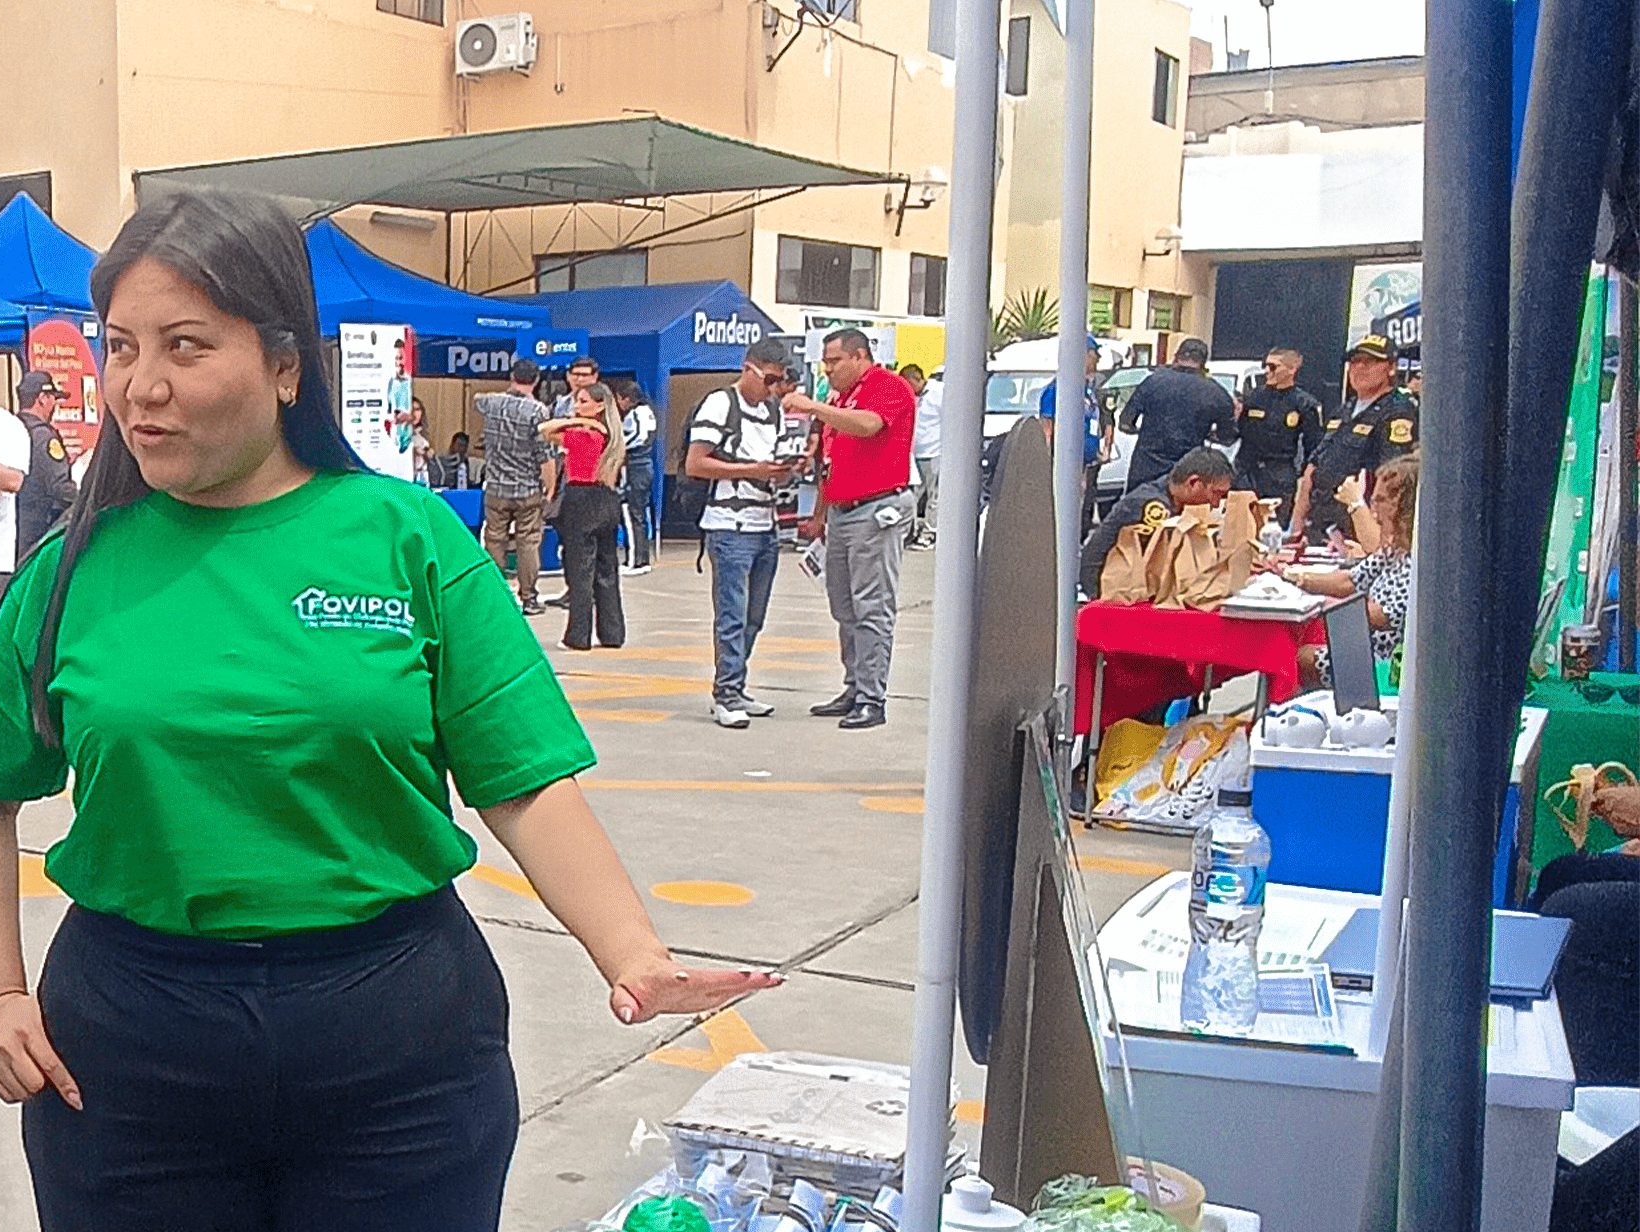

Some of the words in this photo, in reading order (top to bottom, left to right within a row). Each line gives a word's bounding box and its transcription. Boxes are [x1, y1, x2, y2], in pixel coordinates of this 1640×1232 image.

[693, 311, 761, 344] Pandero
[448, 345, 517, 374] Pan
[306, 594, 416, 624] FOVIPOL
